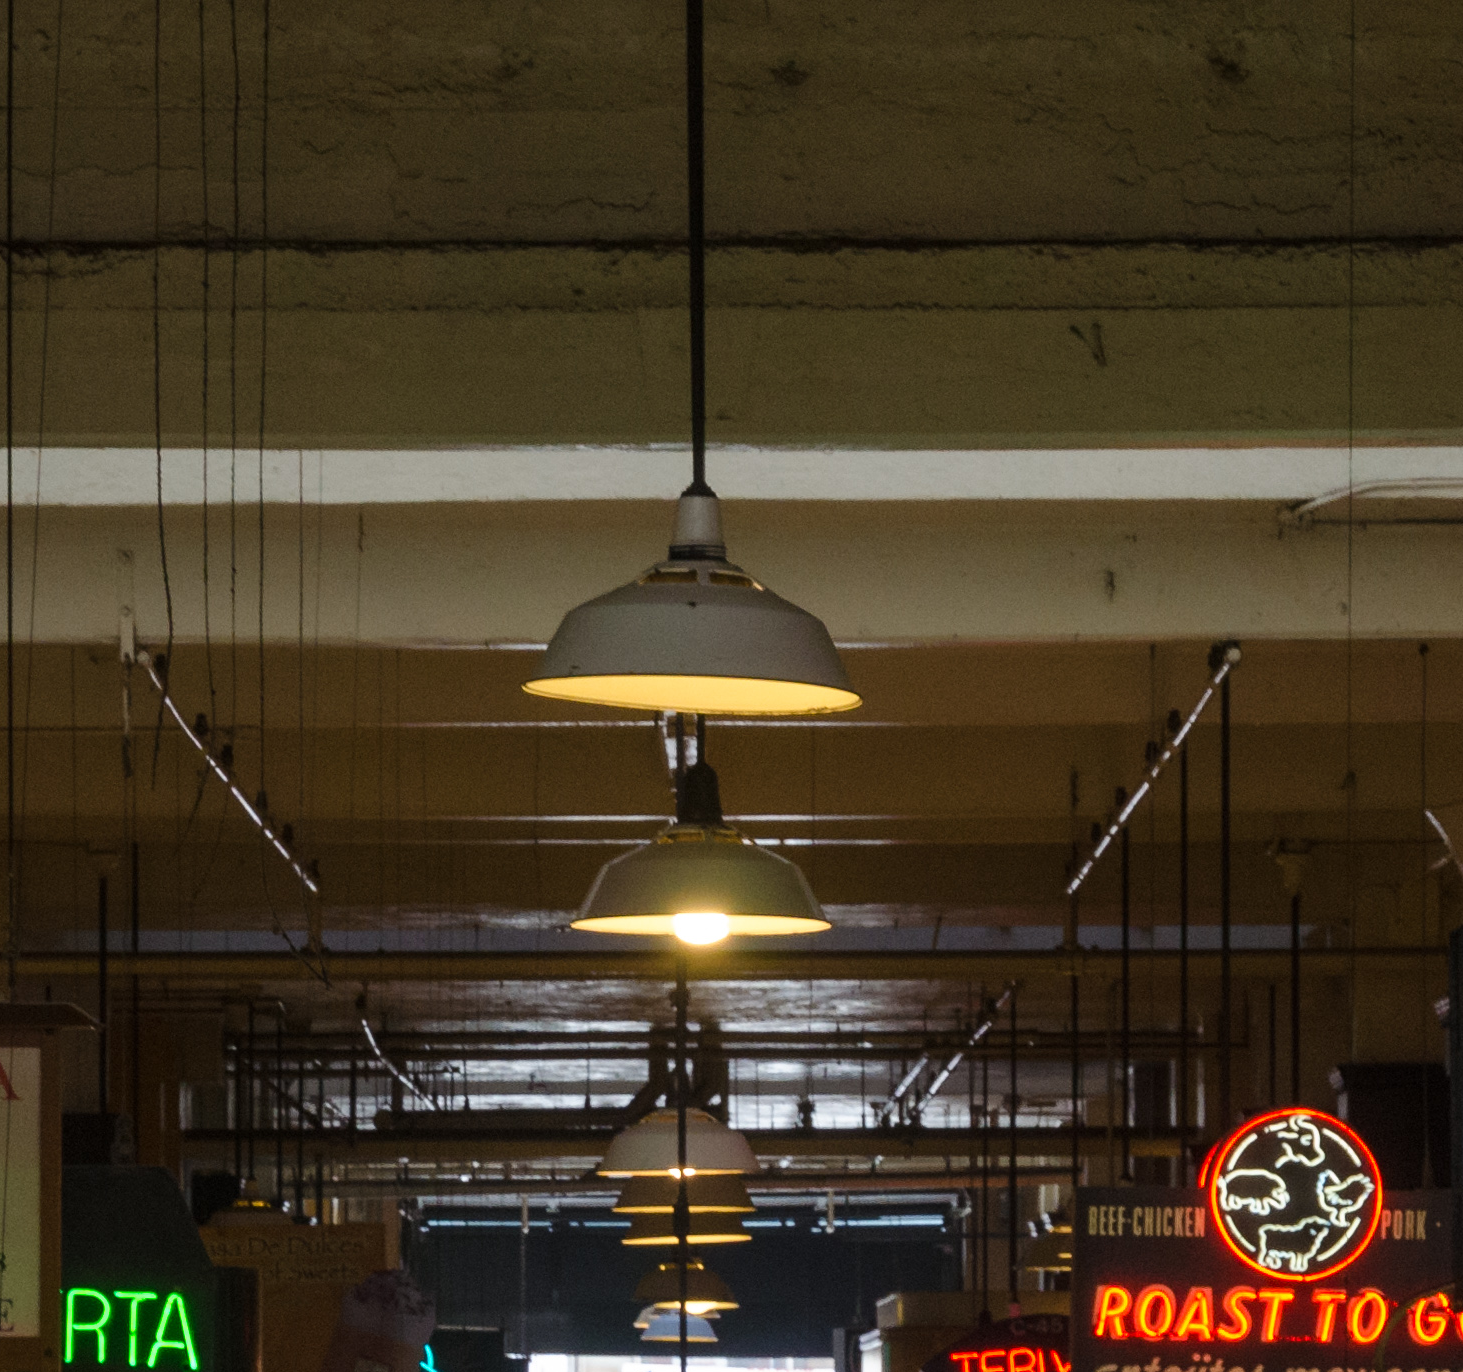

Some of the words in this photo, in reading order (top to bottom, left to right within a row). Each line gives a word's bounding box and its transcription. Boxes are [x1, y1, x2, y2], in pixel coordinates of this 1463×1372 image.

[1379, 1209, 1428, 1241] PORK
[1092, 1283, 1295, 1343] ROAST
[1311, 1289, 1390, 1344] TO
